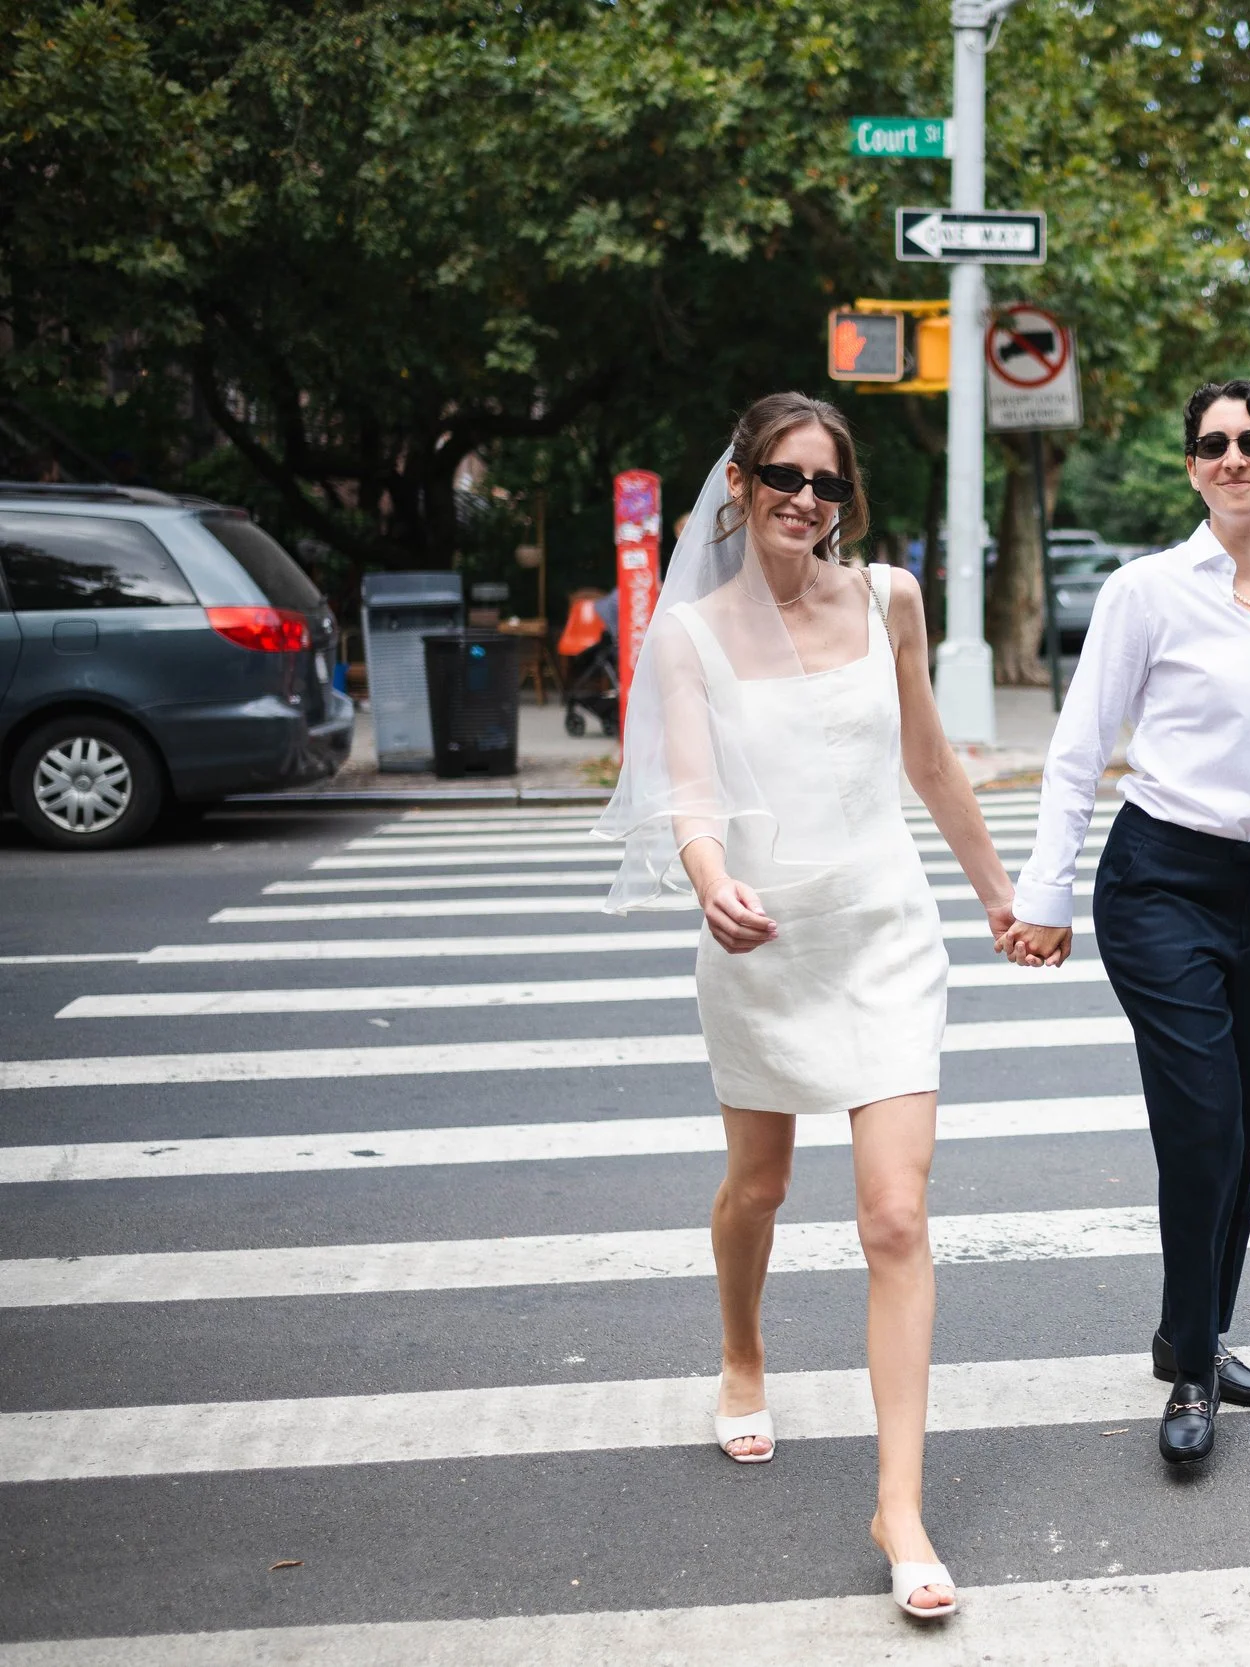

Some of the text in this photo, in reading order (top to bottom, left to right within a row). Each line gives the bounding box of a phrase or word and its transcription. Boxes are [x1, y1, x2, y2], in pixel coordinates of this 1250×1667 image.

[857, 122, 917, 153] Court
[924, 224, 1025, 248] ONE WAY
